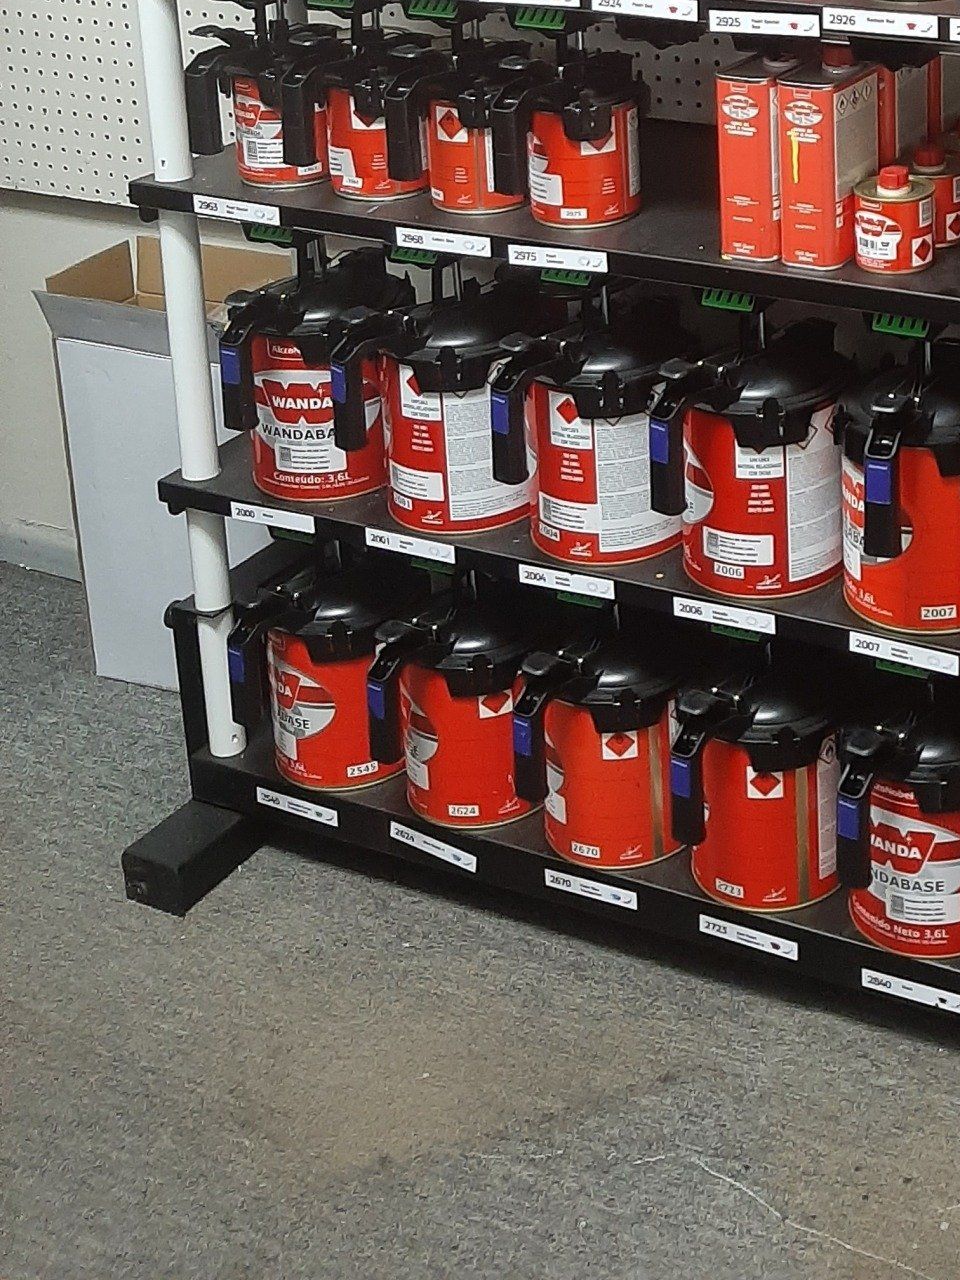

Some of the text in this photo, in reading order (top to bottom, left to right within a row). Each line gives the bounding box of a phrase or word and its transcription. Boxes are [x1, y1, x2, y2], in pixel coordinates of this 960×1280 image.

[716, 16, 741, 27] 2925
[829, 14, 856, 26] 2926
[513, 250, 537, 262] 2975
[271, 395, 334, 411] WANDA
[273, 471, 325, 485] Conteúdo:
[235, 506, 255, 519] 2000
[370, 533, 390, 547] 2001
[524, 569, 546, 583] 2004
[715, 564, 742, 577] 2006
[678, 603, 702, 617] 2006
[923, 607, 954, 619] 2007
[855, 639, 880, 653] 2007
[349, 762, 377, 776] 2545
[450, 806, 476, 816] 2624
[573, 843, 598, 857] 2670
[893, 924, 921, 939] Neto
[924, 928, 950, 940] 3,6L
